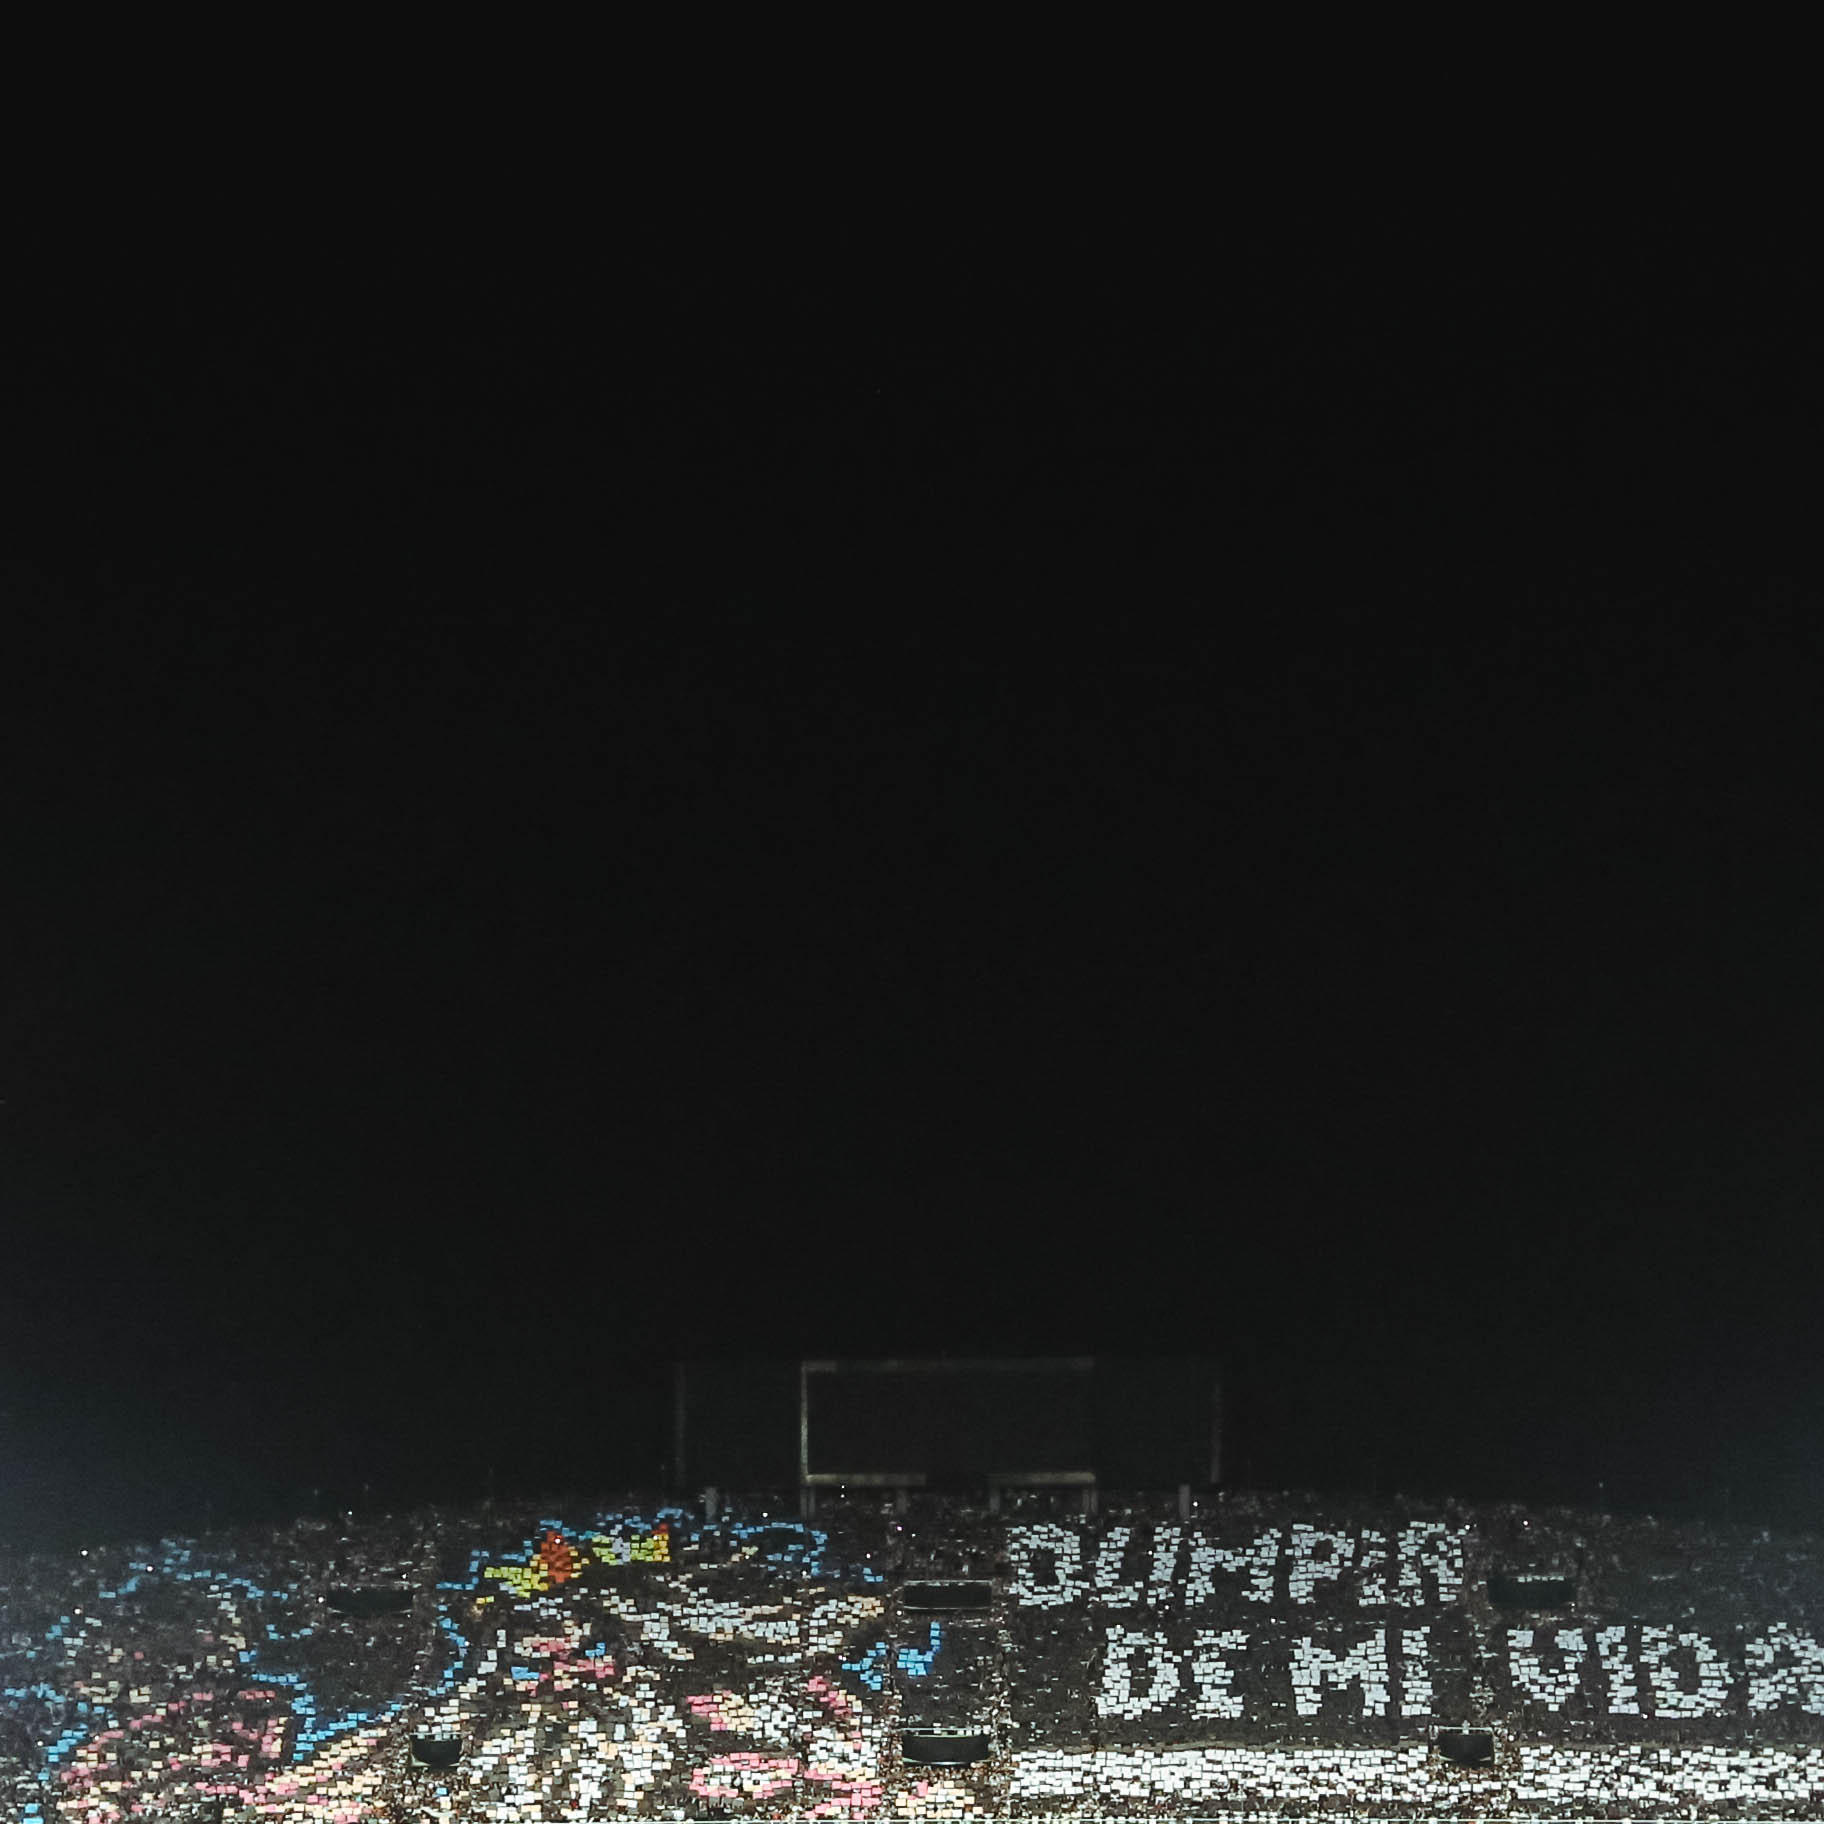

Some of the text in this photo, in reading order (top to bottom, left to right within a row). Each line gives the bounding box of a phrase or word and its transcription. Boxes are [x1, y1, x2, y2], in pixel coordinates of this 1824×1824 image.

[1010, 1521, 1465, 1609] OLIMPIA
[1096, 1625, 1248, 1720] DE
[1289, 1625, 1432, 1716] MI
